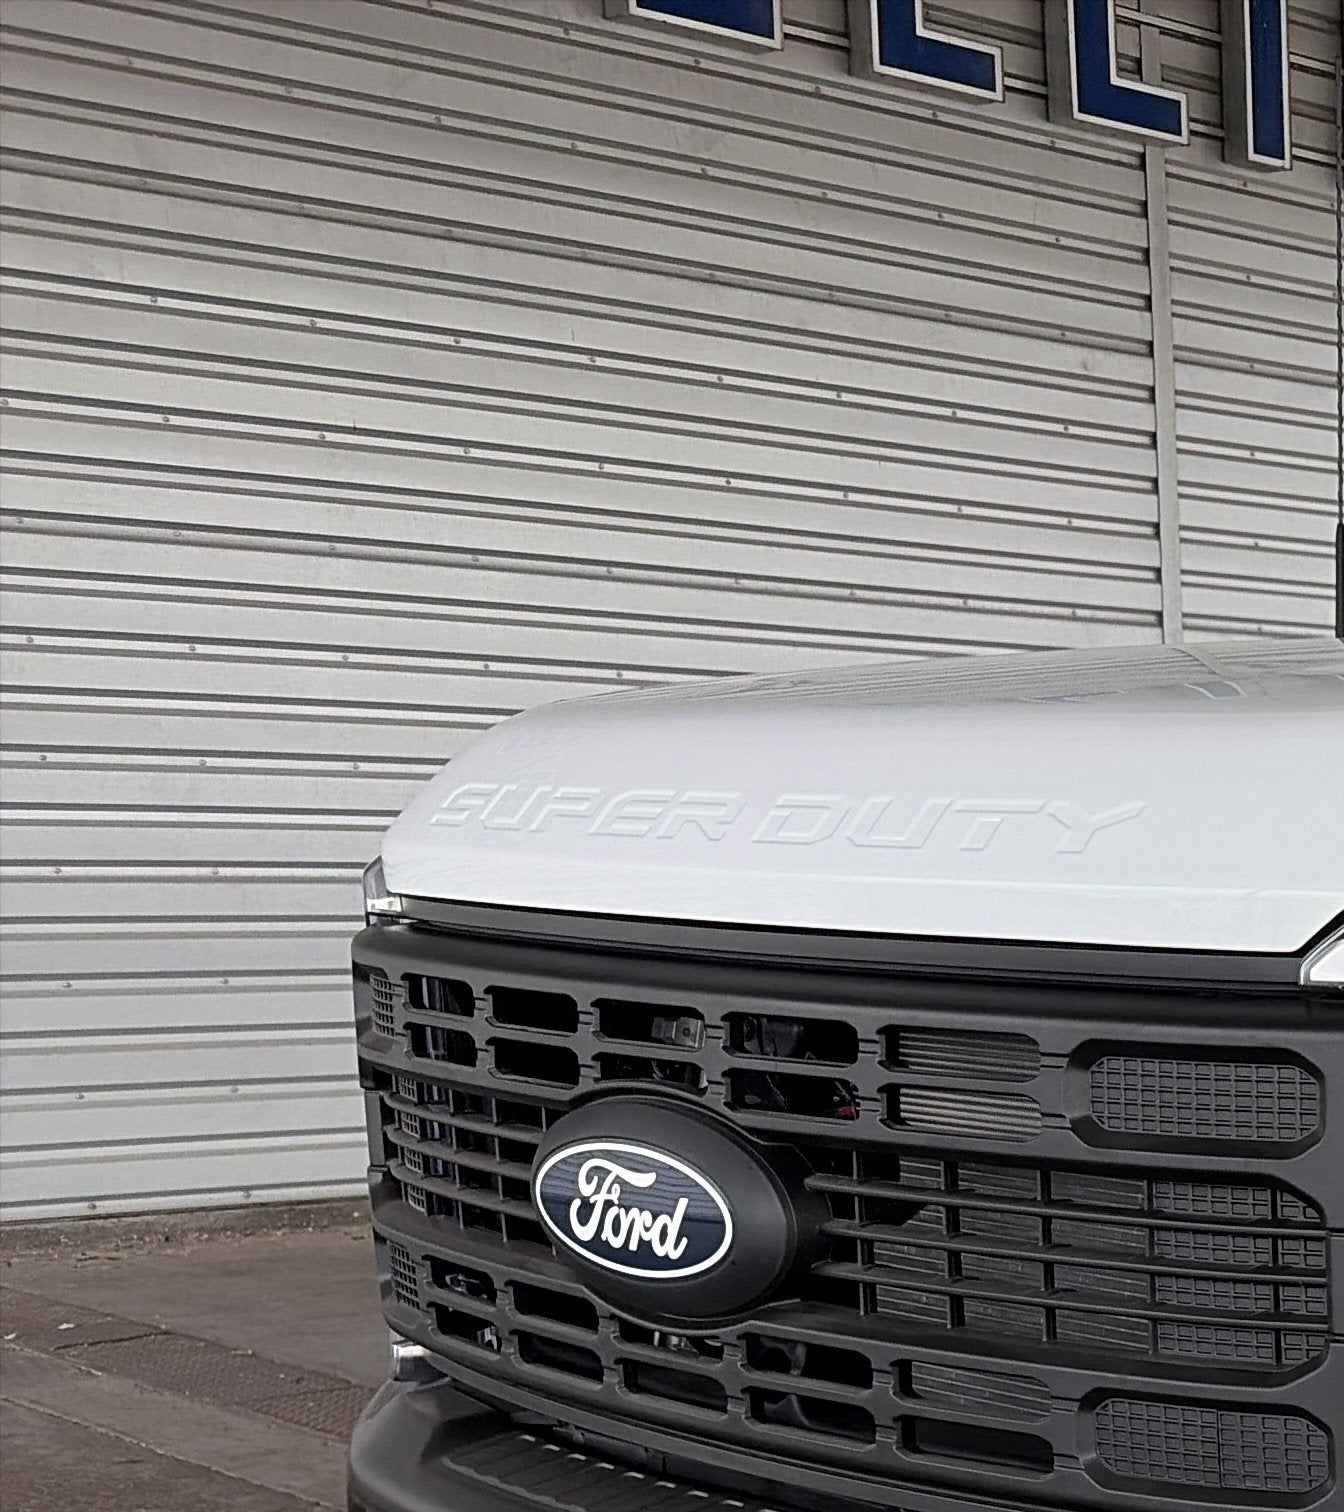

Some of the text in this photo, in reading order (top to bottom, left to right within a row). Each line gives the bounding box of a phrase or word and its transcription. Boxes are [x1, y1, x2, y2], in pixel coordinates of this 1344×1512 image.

[430, 783, 1147, 854] SUPER DUTY
[569, 1157, 689, 1261] Ford
